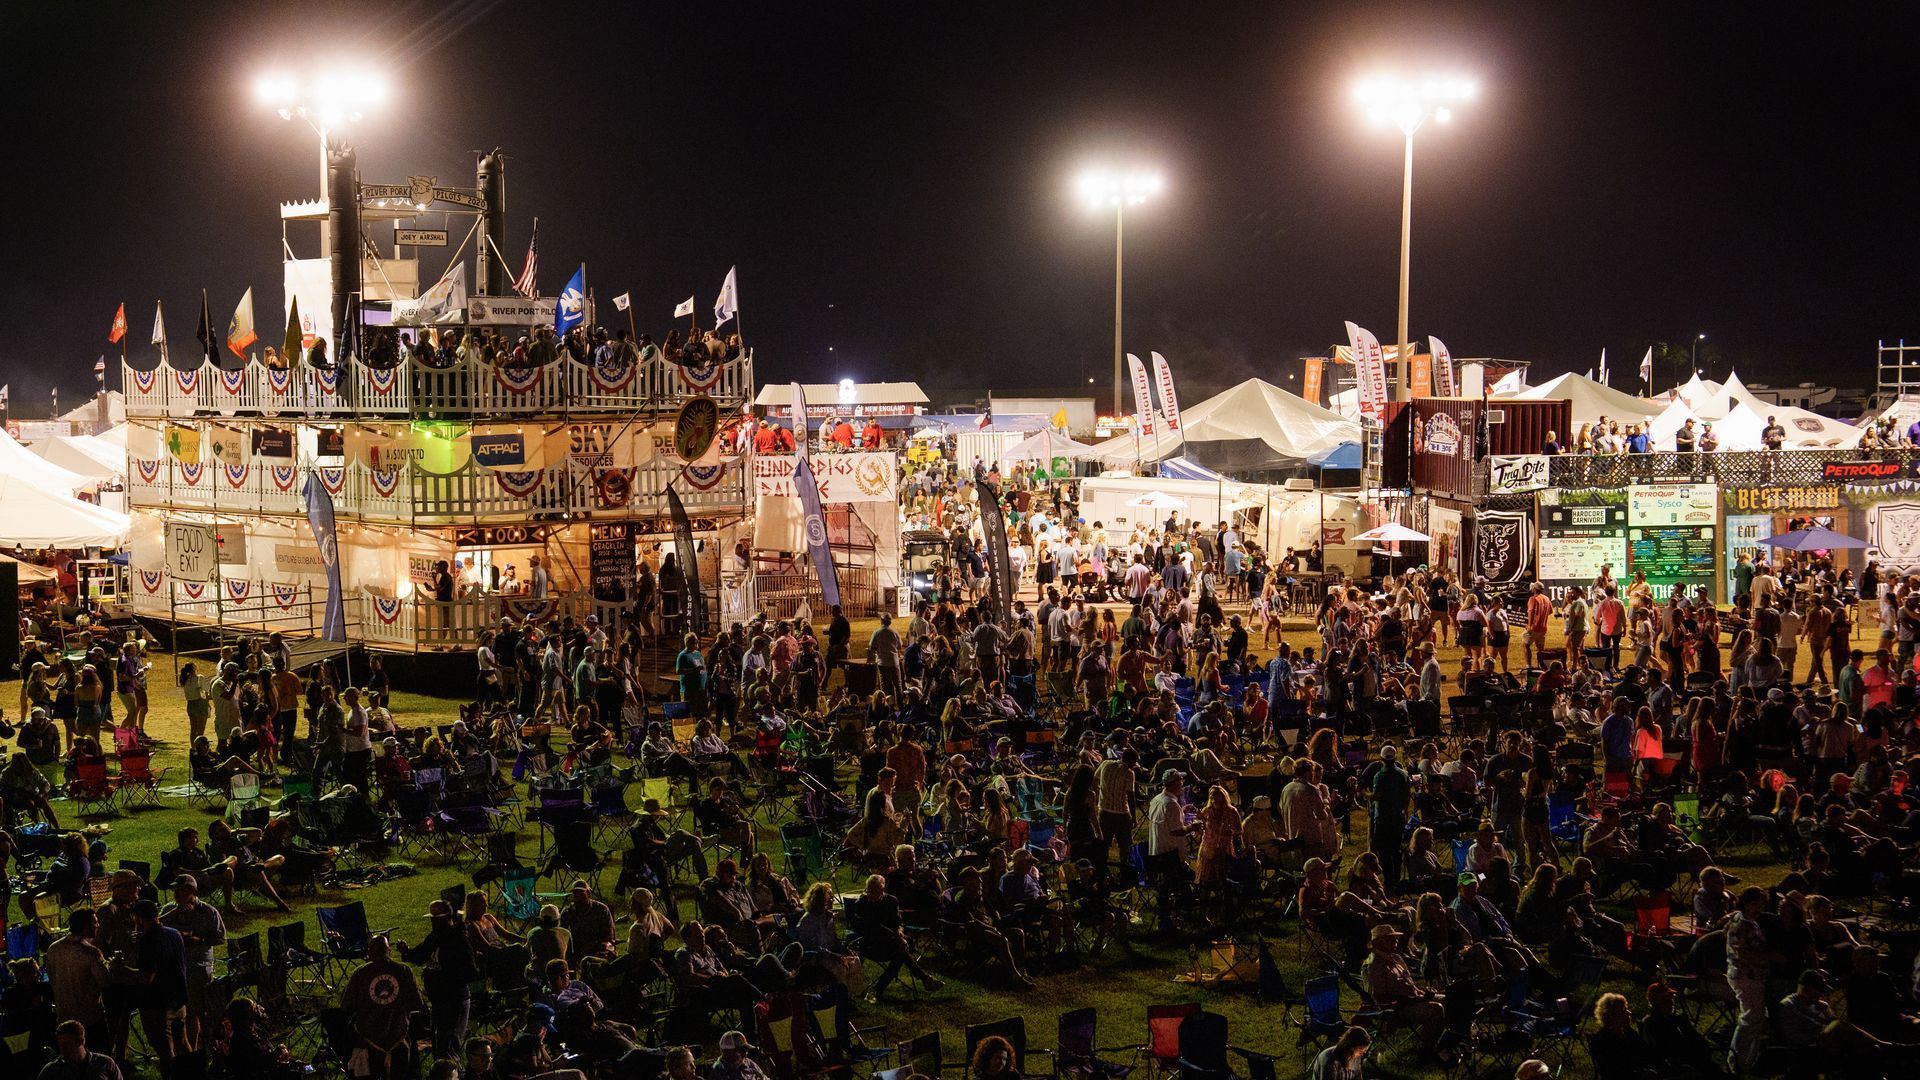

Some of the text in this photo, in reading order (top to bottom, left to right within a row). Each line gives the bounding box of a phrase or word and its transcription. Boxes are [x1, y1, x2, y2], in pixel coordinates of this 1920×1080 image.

[365, 187, 486, 208] RIVER PORK PILOTS 2020
[400, 233, 416, 241] JOEY
[491, 307, 516, 316] RIVER
[518, 307, 540, 316] PORT
[864, 404, 906, 413] NEW ENGLAND
[570, 424, 613, 454] SKY
[571, 456, 614, 468] ESOURCES
[1657, 499, 1682, 509] Sysco
[1737, 487, 1783, 509] BEST
[486, 526, 527, 543] FOOD
[591, 525, 627, 540] MENU
[1738, 525, 1758, 538] EAT
[175, 528, 204, 553] FOOD
[180, 554, 200, 573] EXIT
[409, 556, 438, 571] DELTA
